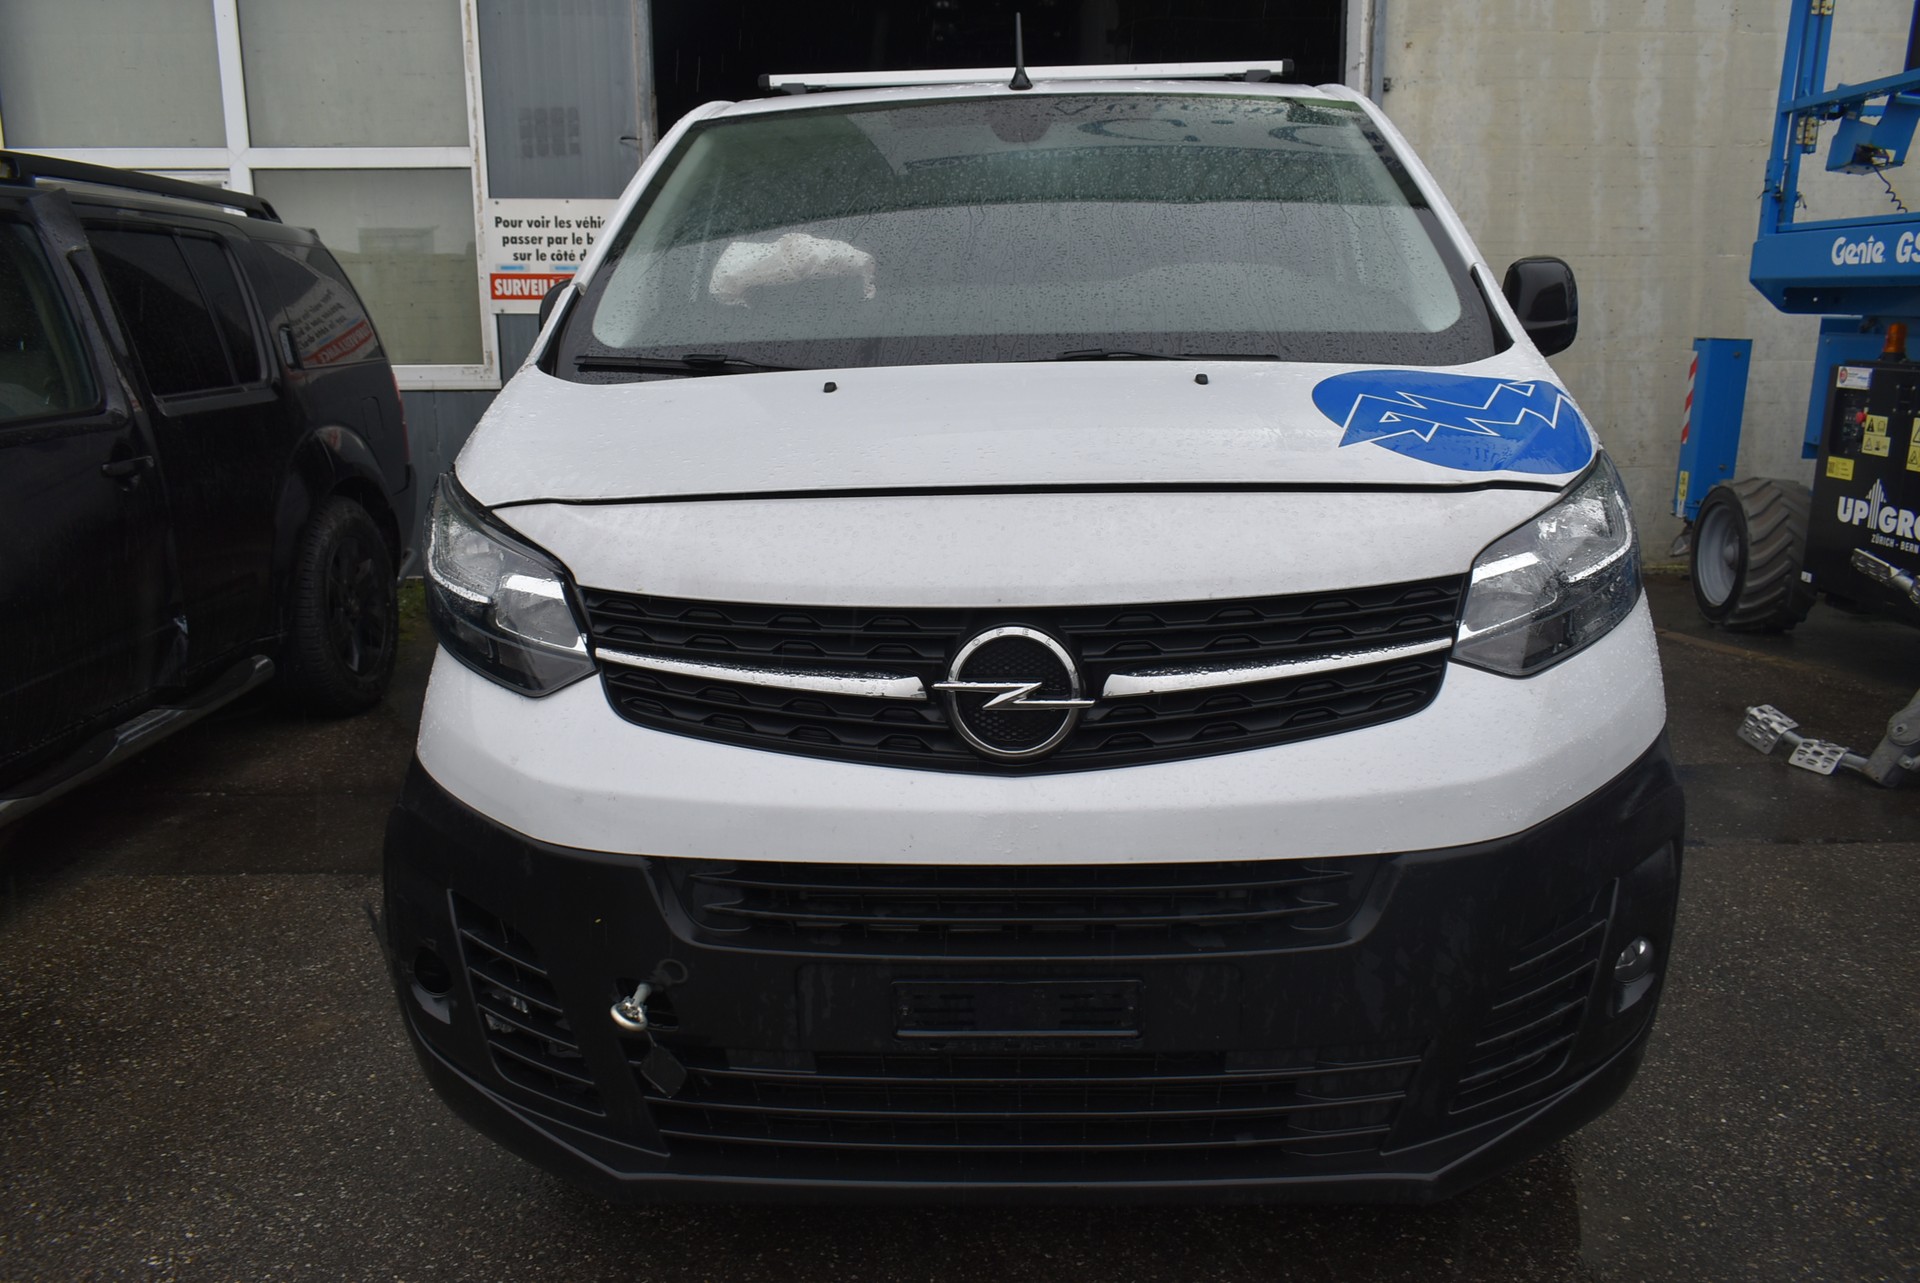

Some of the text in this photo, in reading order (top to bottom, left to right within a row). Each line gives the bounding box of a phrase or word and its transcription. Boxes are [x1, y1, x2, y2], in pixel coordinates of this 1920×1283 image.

[494, 215, 523, 229] Pour
[526, 215, 551, 229] voir
[554, 215, 572, 229] les
[502, 235, 543, 248] passer
[547, 235, 568, 248] par
[571, 232, 583, 245] le
[512, 252, 532, 262] sur
[535, 248, 547, 262] le
[550, 249, 576, 262] côté
[1831, 235, 1885, 266] Genie
[971, 628, 1053, 647] OPEL
